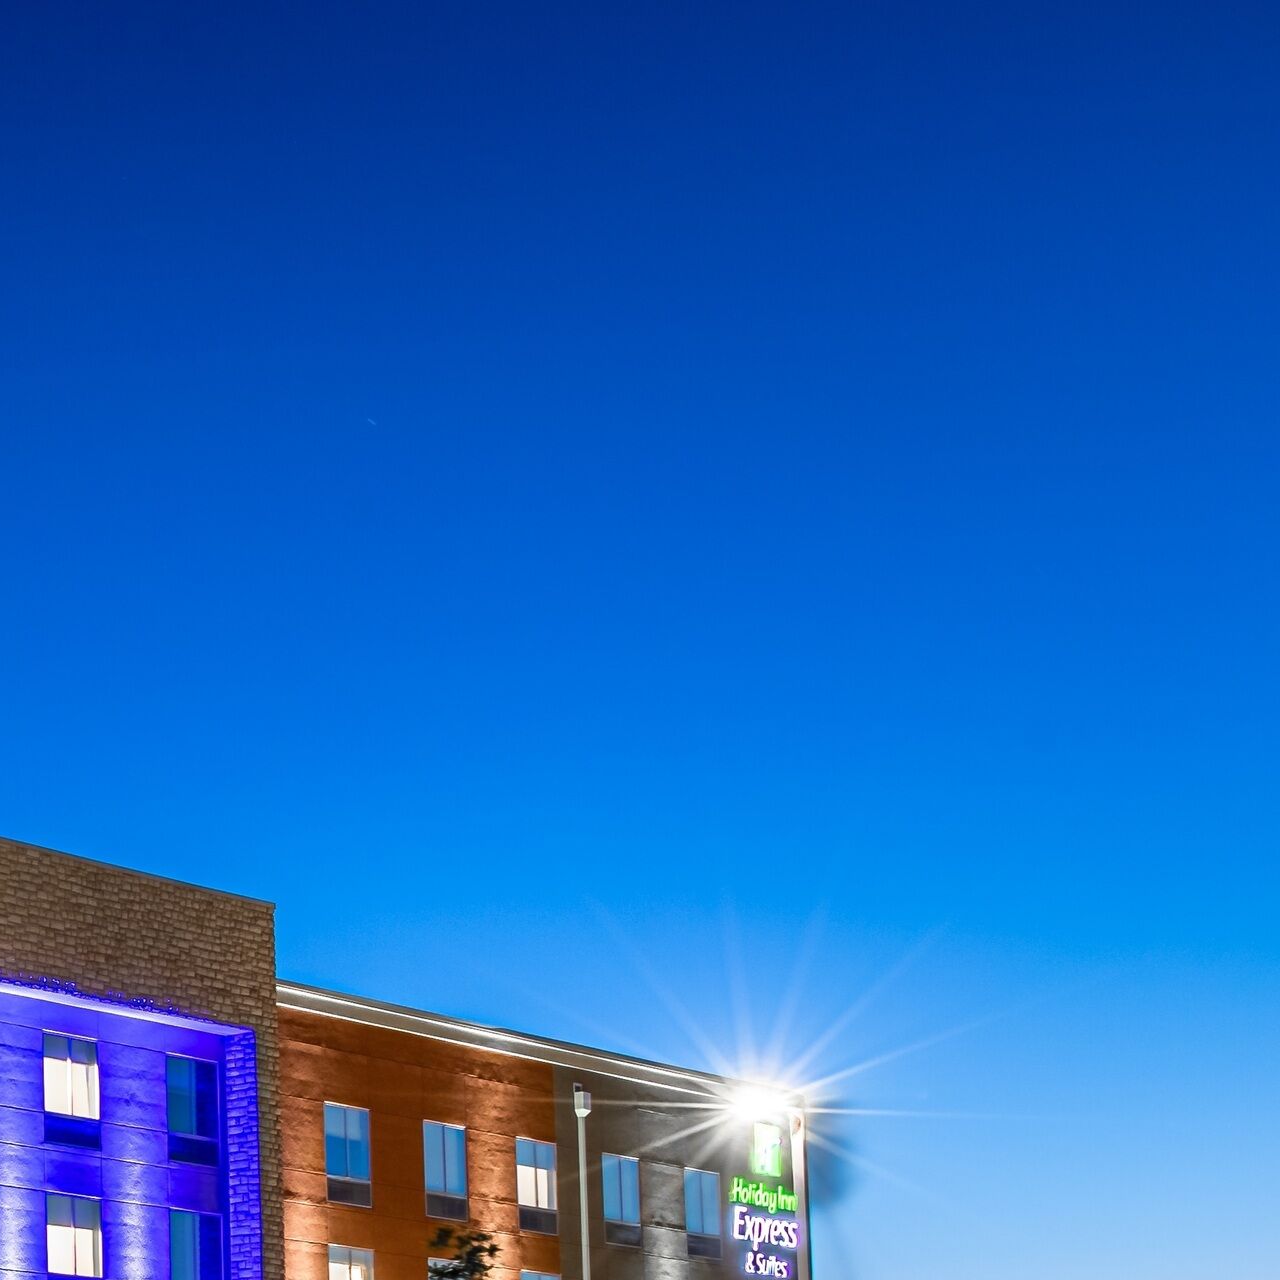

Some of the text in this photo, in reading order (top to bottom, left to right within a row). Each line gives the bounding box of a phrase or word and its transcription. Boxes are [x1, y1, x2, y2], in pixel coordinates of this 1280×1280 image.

[730, 1177, 798, 1213] Holiday Inn
[733, 1205, 799, 1251] Express
[745, 1252, 788, 1278] & Suites
